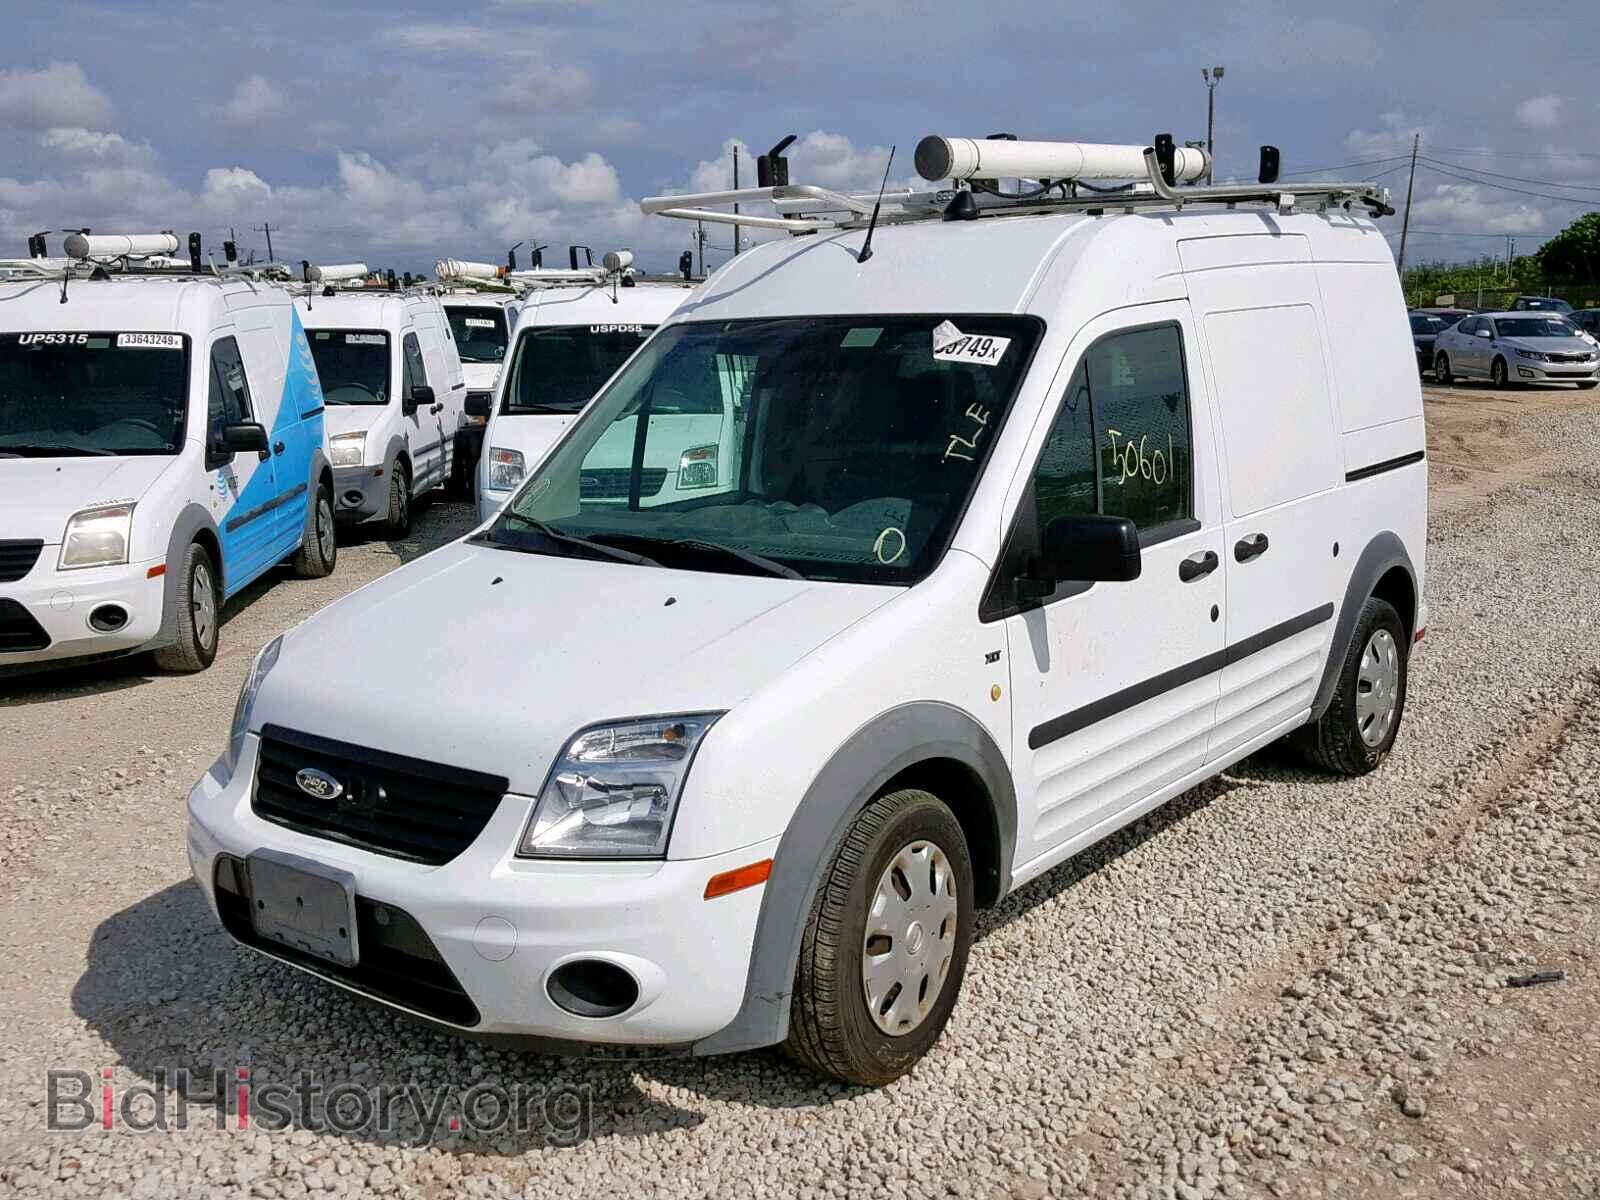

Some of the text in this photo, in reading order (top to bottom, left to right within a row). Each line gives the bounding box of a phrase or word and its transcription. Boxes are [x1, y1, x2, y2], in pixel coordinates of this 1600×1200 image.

[590, 324, 643, 334] USPD55
[18, 333, 88, 345] UP5315
[1107, 428, 1174, 485] 50601
